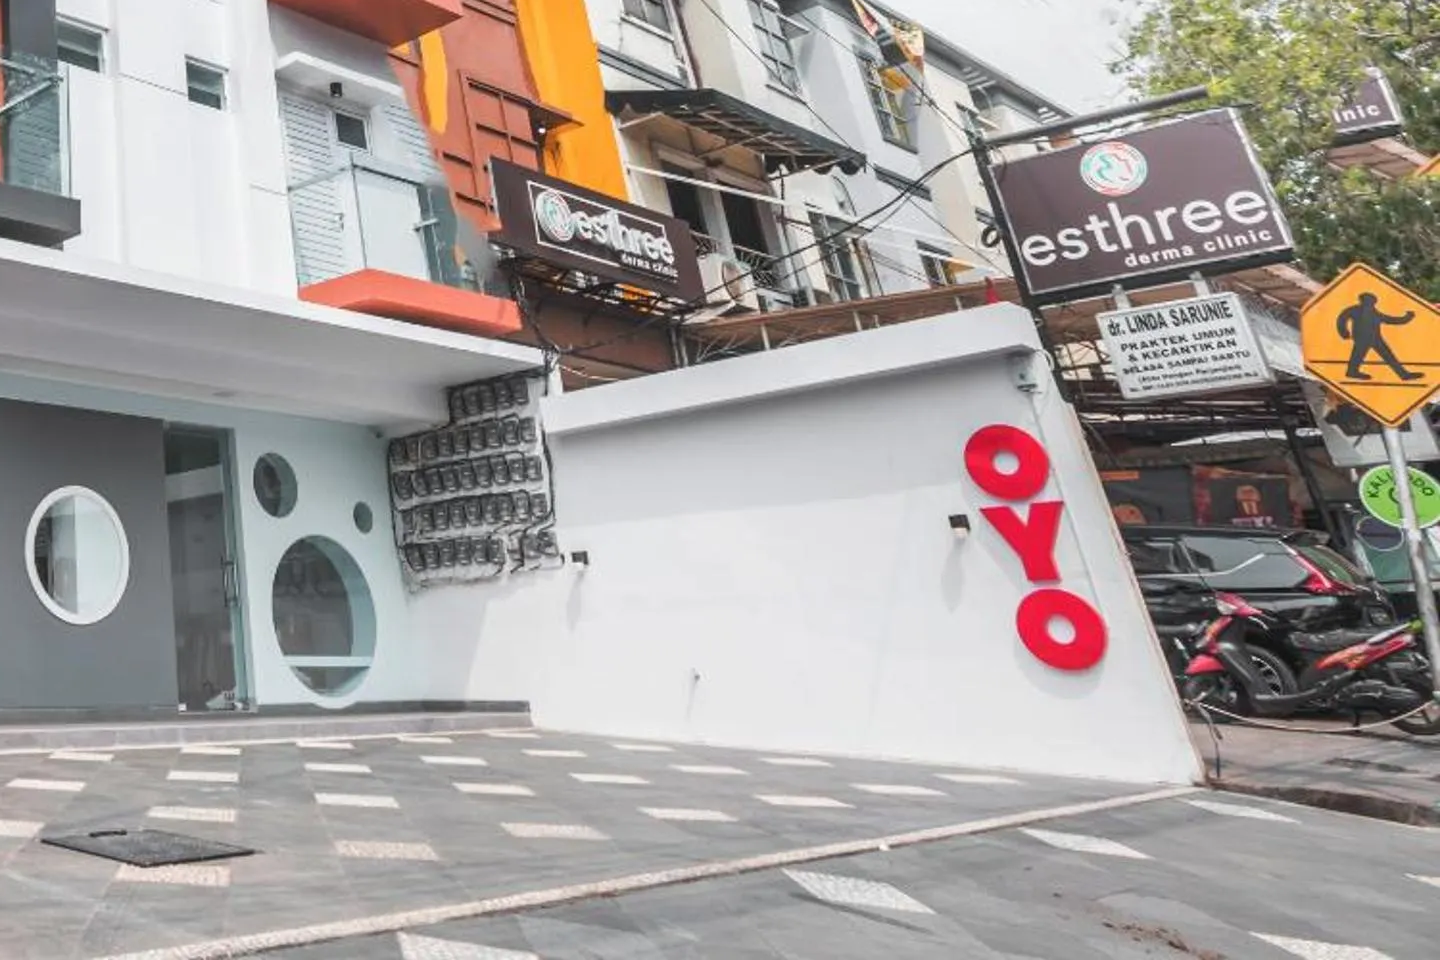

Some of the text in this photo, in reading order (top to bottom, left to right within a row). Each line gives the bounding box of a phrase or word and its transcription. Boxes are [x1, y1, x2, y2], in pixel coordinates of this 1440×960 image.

[1331, 105, 1381, 123] inic
[571, 208, 675, 265] esthree
[1021, 189, 1268, 267] esthree
[1124, 227, 1273, 269] derma clinic
[1107, 300, 1234, 337] dr. LINDA SARUNIE
[1120, 326, 1236, 352] PRAKTEK UMUM
[1141, 338, 1238, 360] KECANTIKAN
[1365, 471, 1436, 498] KALIDO
[963, 423, 1109, 671] OYO
